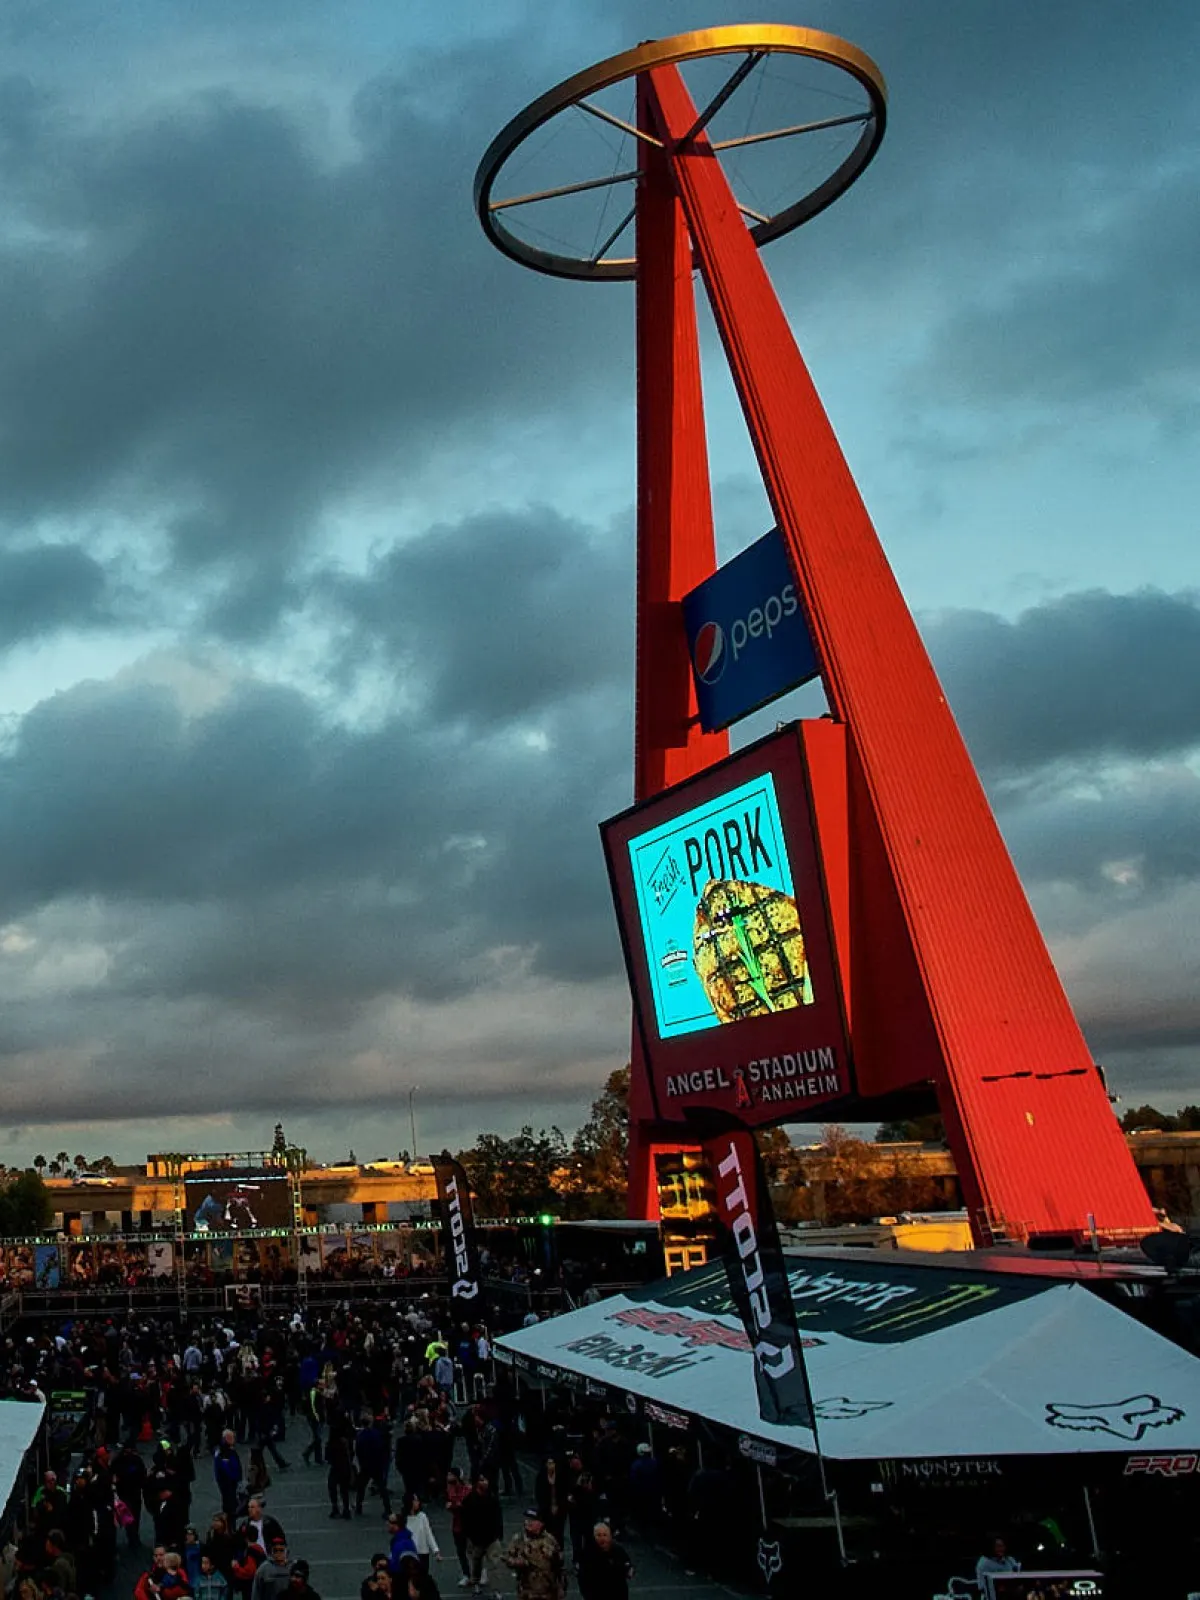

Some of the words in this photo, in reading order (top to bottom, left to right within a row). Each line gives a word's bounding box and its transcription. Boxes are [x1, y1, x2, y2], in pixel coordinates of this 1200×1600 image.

[730, 582, 799, 661] peps
[684, 806, 773, 897] PORK
[665, 1066, 731, 1097] ANGEL
[747, 1046, 836, 1082] STADIUM
[761, 1074, 839, 1102] ANAHEIM
[788, 1269, 919, 1313] NSTER
[901, 1459, 1004, 1479] MONSTER
[1122, 1454, 1198, 1478] PRO
